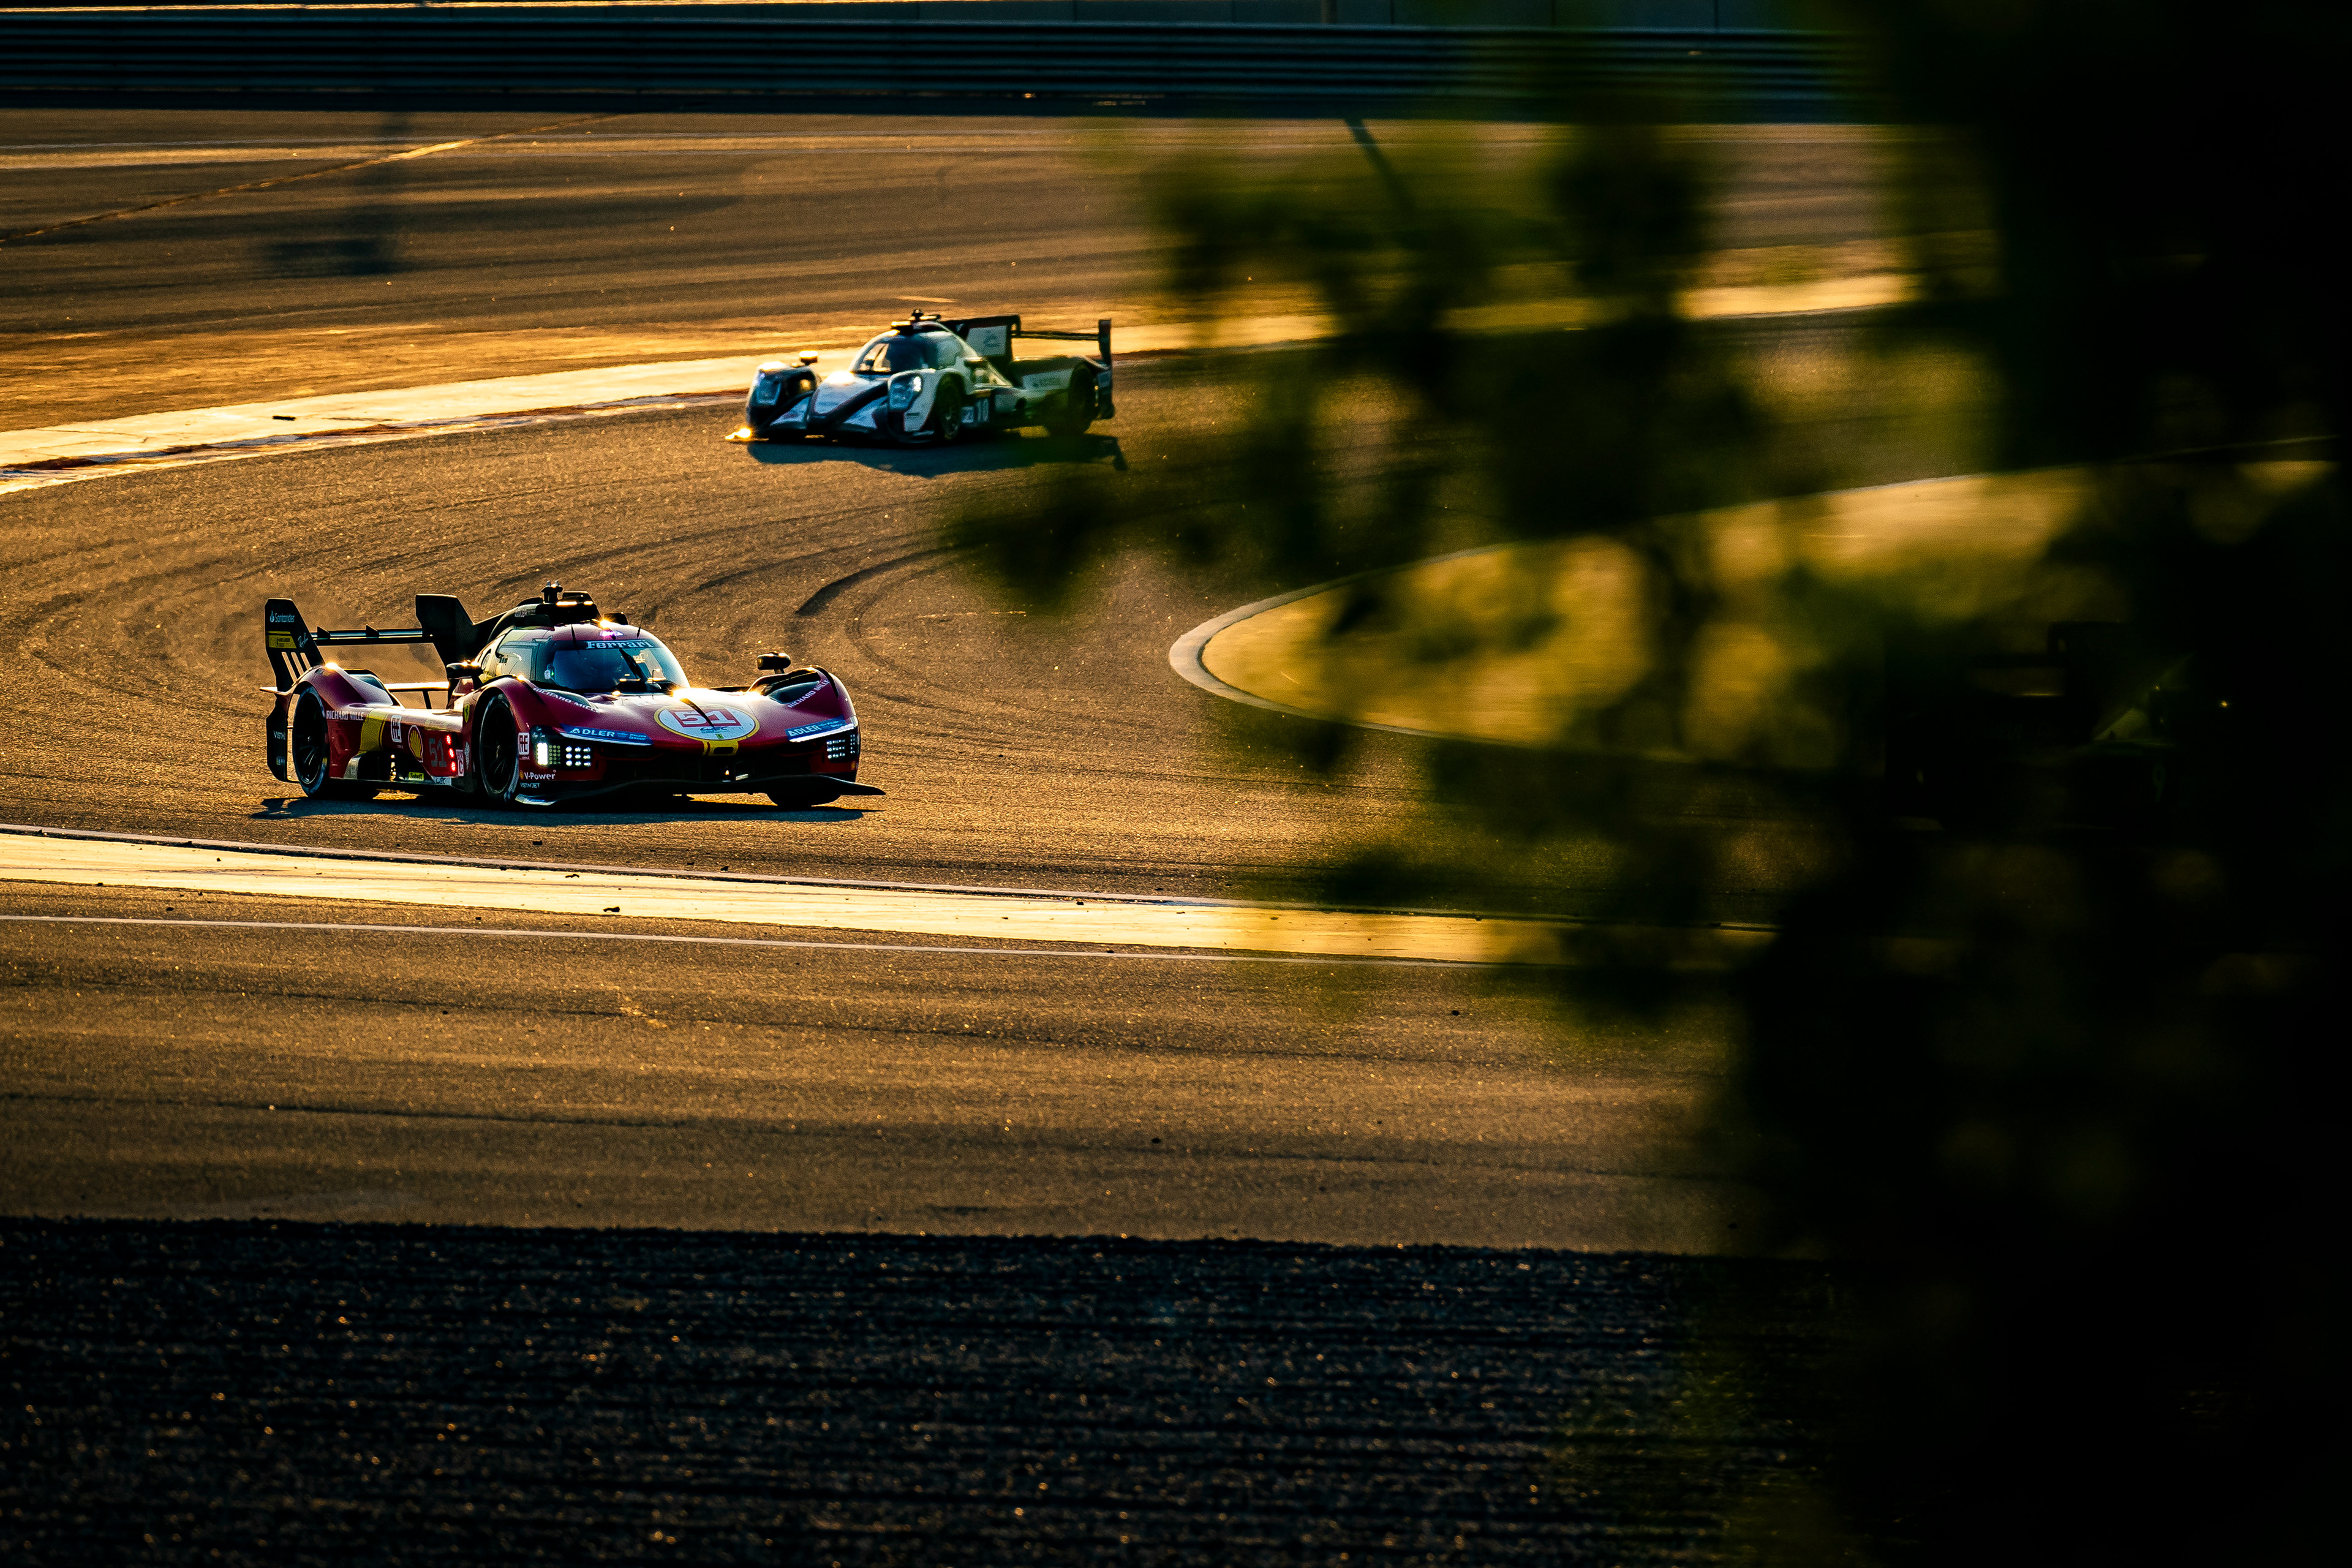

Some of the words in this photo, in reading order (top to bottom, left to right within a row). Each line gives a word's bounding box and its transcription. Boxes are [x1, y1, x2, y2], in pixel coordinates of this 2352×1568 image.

[586, 640, 654, 649] Ferrari
[533, 687, 572, 703] RICHARD
[787, 690, 816, 708] RICHARD
[814, 679, 831, 692] MILLE
[326, 710, 349, 720] RICHARD
[674, 710, 736, 725] 51
[570, 728, 615, 737] ADLER
[788, 724, 822, 737] ADLER
[429, 738, 447, 767] 51
